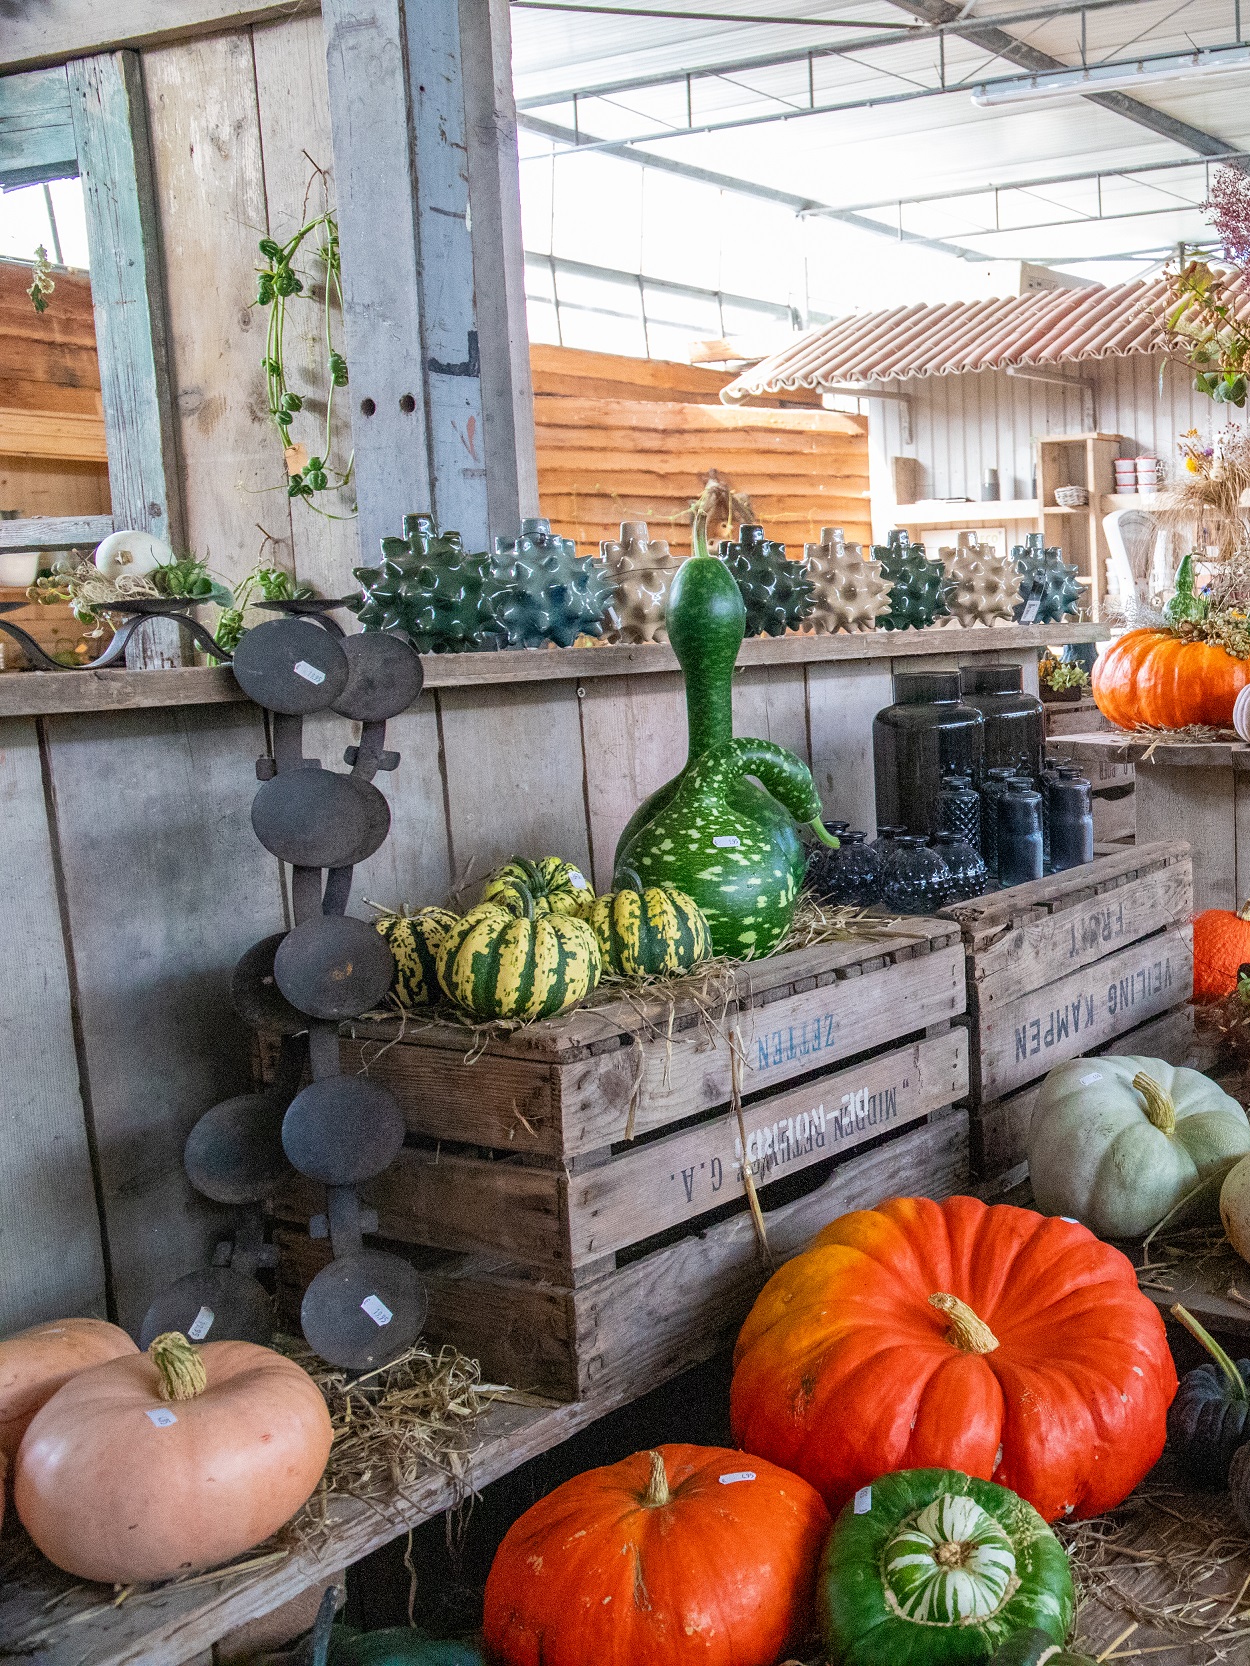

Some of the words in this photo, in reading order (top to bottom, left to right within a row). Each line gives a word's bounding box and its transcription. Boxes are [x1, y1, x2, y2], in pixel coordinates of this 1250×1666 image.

[1106, 957, 1174, 1016] VEILING
[755, 1013, 835, 1071] ZETTEN
[1013, 993, 1095, 1064] KAMPEN
[670, 1157, 723, 1203] G.A.
